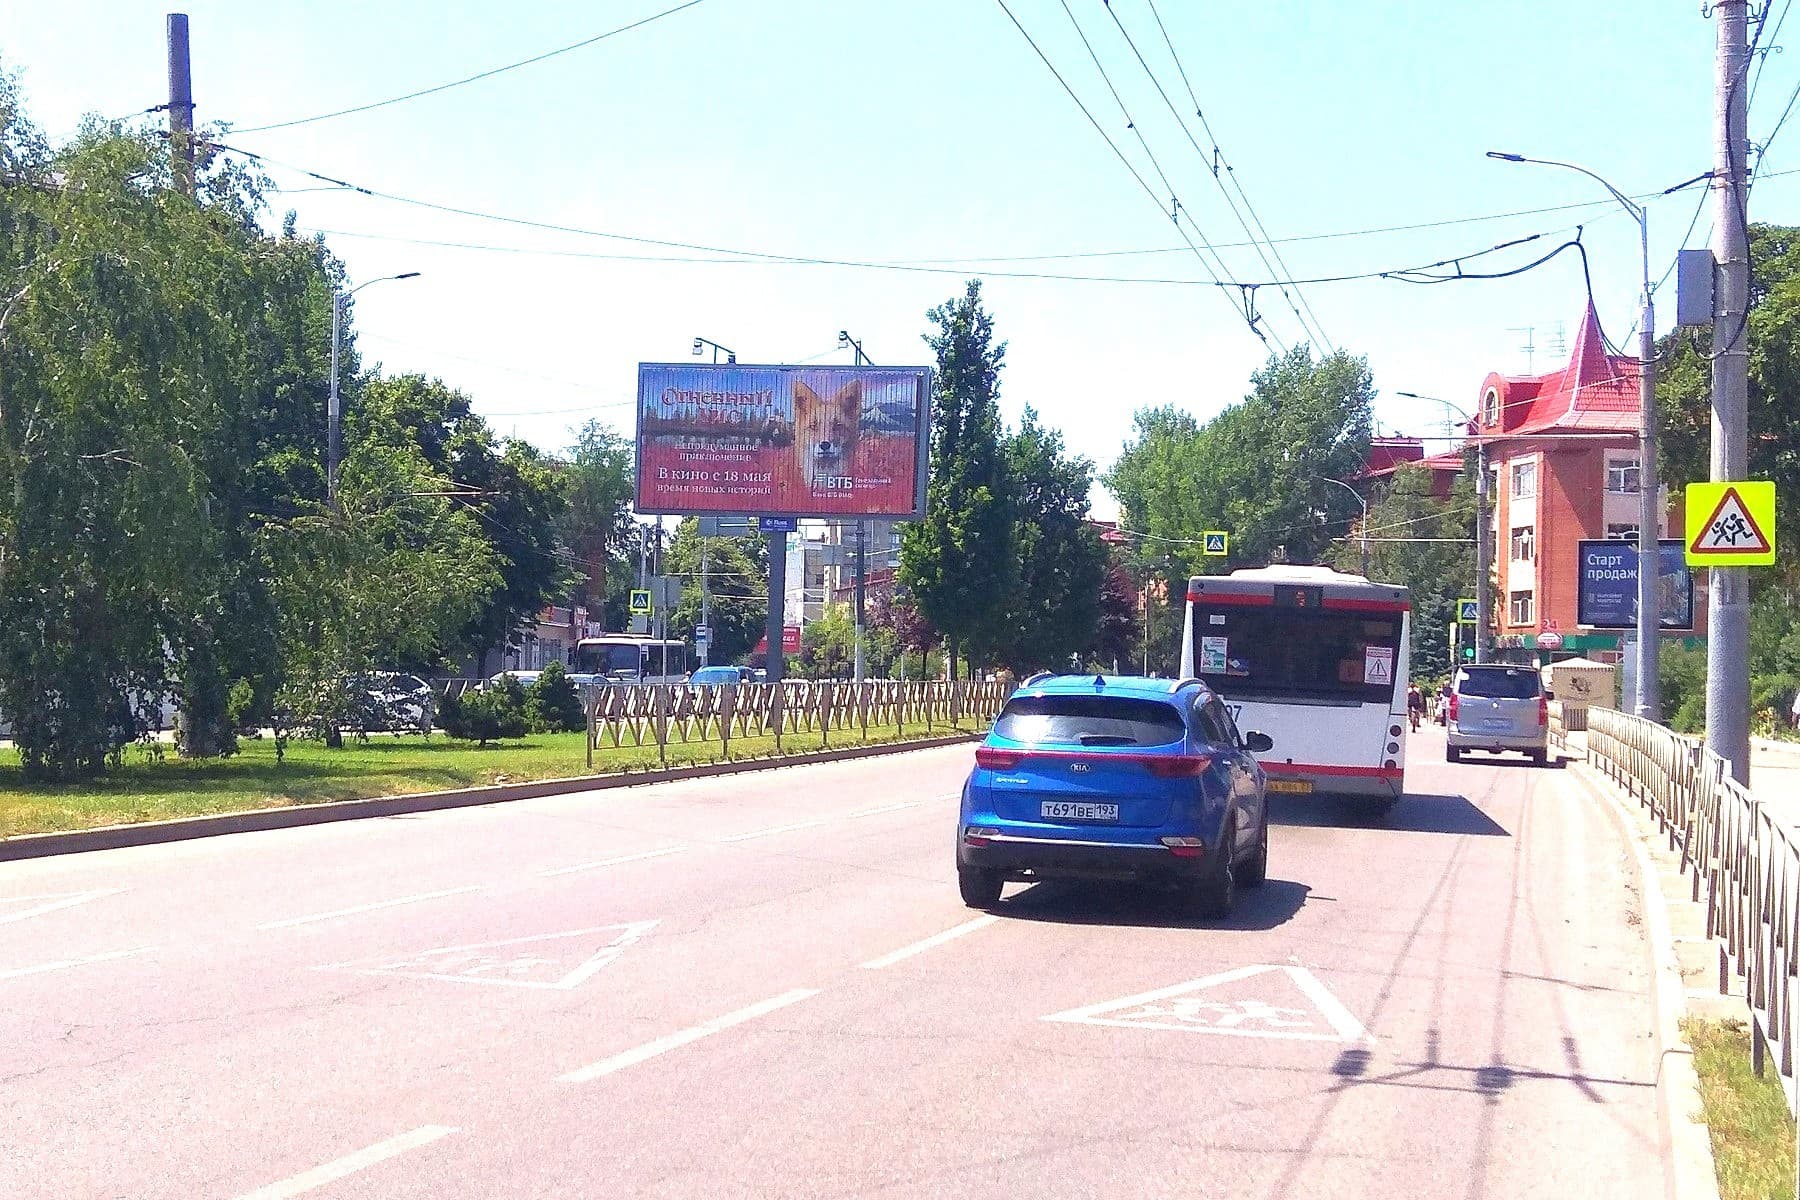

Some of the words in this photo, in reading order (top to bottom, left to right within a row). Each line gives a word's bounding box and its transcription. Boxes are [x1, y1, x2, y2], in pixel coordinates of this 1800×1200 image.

[659, 466, 668, 480] В
[672, 469, 709, 481] кино
[713, 471, 721, 481] с
[724, 470, 739, 482] 18
[743, 472, 772, 483] мая
[657, 483, 689, 494] время
[827, 476, 853, 489] ВТБ
[1587, 553, 1623, 568] Старт
[1587, 569, 1638, 581] продаж
[1074, 763, 1088, 772] KIA
